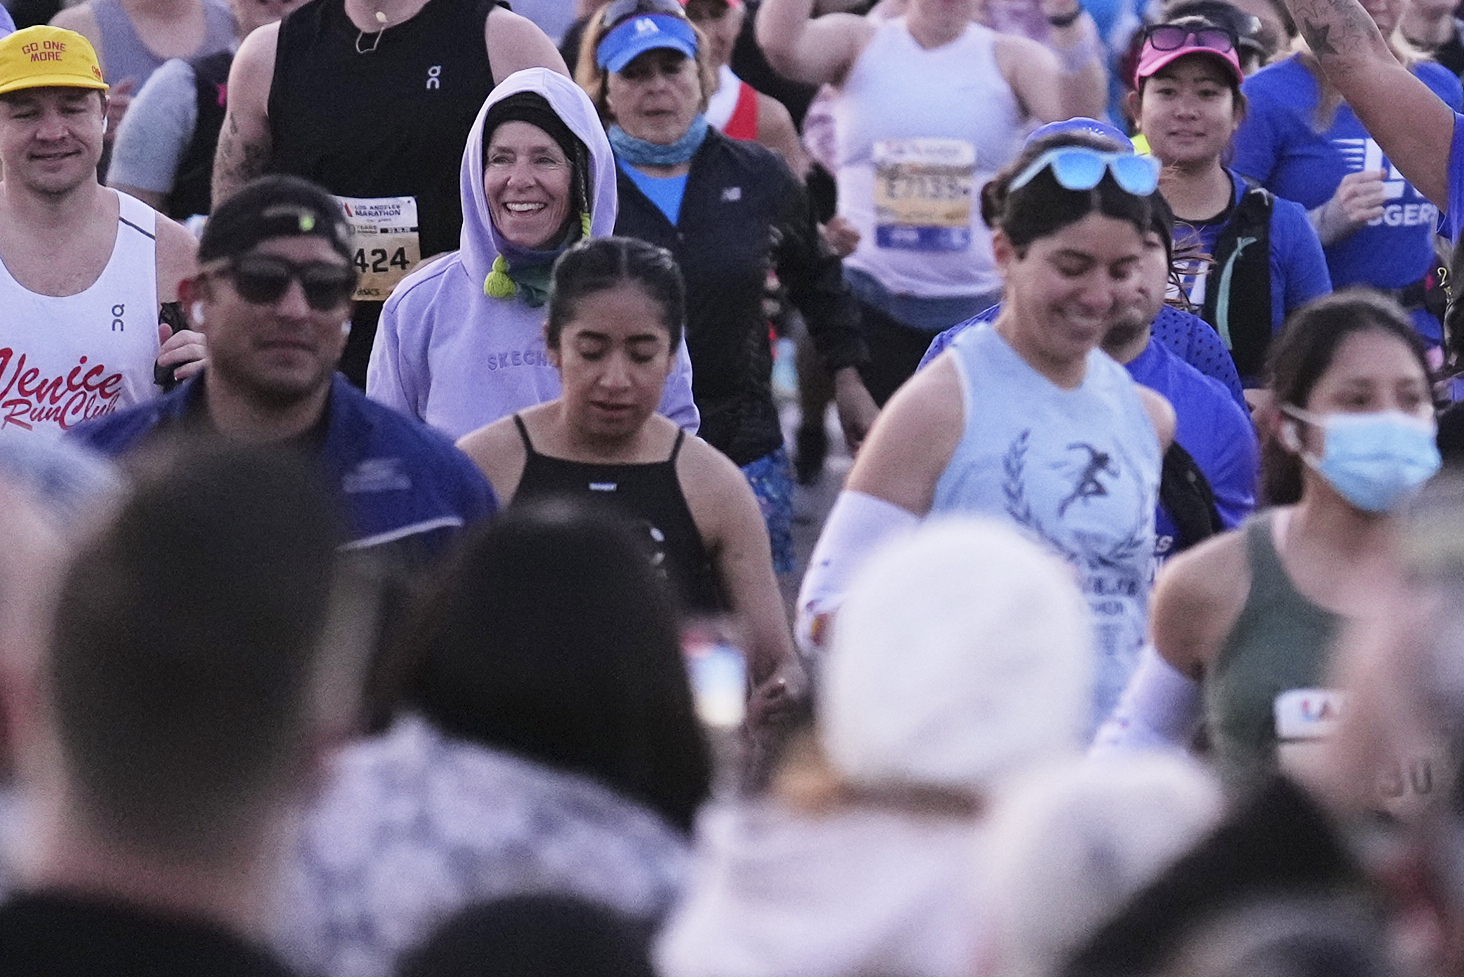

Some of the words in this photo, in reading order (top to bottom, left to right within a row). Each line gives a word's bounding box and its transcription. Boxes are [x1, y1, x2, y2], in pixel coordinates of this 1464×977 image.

[22, 42, 39, 55] GO
[43, 40, 66, 52] ONE
[30, 51, 63, 62] MORE
[355, 209, 401, 217] MARATHON
[353, 246, 410, 273] 424
[487, 349, 552, 371] SKECH
[0, 347, 123, 404] Venice
